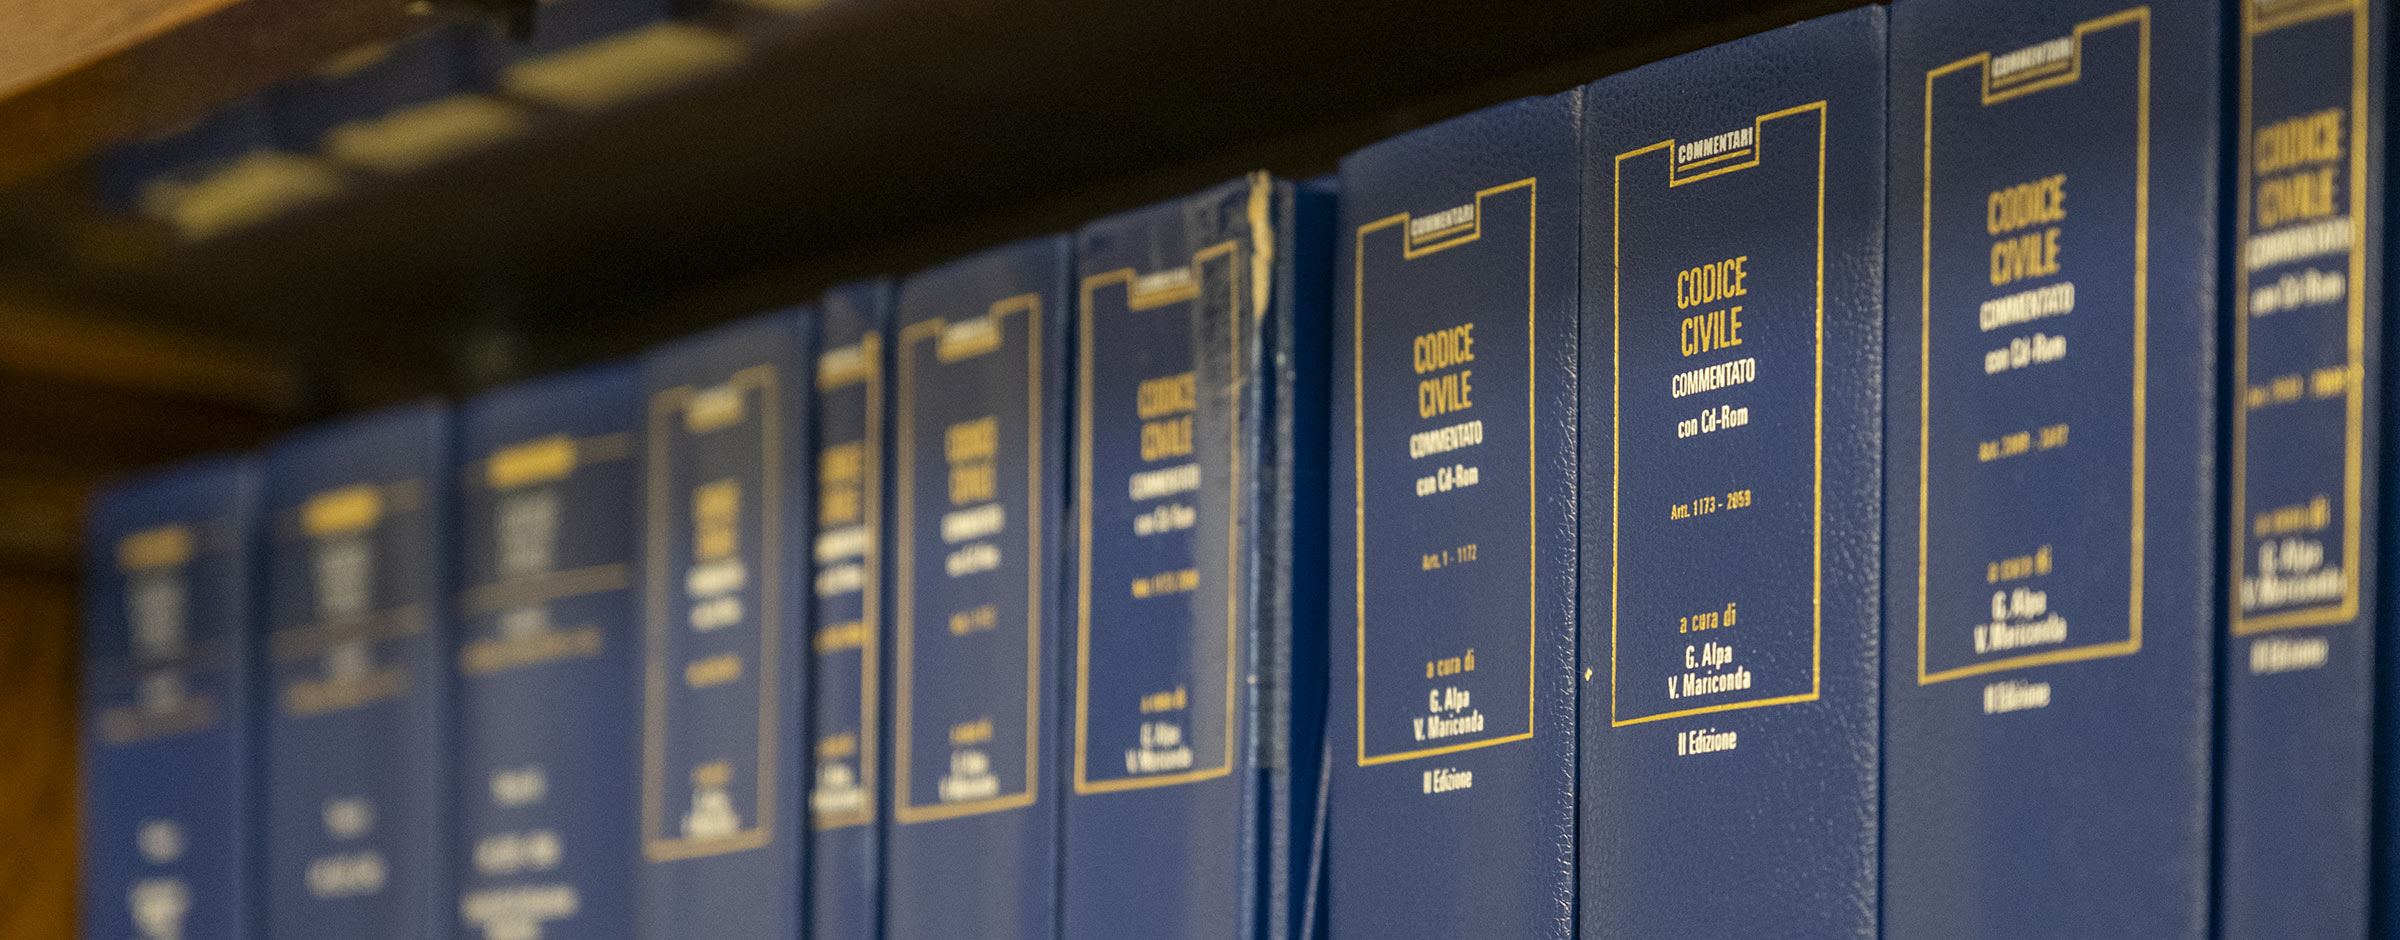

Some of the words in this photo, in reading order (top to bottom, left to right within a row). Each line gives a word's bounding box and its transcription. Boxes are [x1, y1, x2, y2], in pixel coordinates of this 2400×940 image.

[1678, 127, 1754, 164] COMMENTARI
[1411, 203, 1475, 237] COMMENTARI
[1988, 174, 2067, 235] CODICE
[1990, 227, 2061, 286] CIVILE
[1677, 256, 1747, 309] CODICE
[1414, 322, 1475, 375] CODICE
[1681, 306, 1743, 357] CIVILE
[1419, 370, 1473, 418] CIVILE
[1672, 358, 1756, 398] COMMENTATO
[1678, 418, 1698, 439] con
[1701, 405, 1749, 434] Cd-Rom
[1410, 420, 1483, 459] COMMENTATO
[1417, 475, 1437, 497] con
[1438, 464, 1479, 492] Cd-Rom
[1671, 504, 1690, 520] Artt.
[1693, 496, 1716, 517] 1173
[1680, 617, 1688, 634] a
[1692, 612, 1718, 632] cura
[1723, 603, 1736, 627] di
[1426, 661, 1435, 679] a
[1437, 657, 1461, 677] cura
[1464, 648, 1475, 672] di
[1686, 645, 1699, 669] G.
[1702, 642, 1732, 670] Alpa
[1668, 676, 1680, 699] V.
[1683, 666, 1751, 697] Mariconda
[1430, 689, 1443, 713] G.
[1444, 687, 1470, 713] Alpa
[1414, 718, 1426, 741] V.
[1428, 710, 1484, 739] Mariconda
[1678, 732, 1687, 756] II
[1689, 728, 1737, 755] Edizione
[1433, 768, 1473, 793] Edizione
